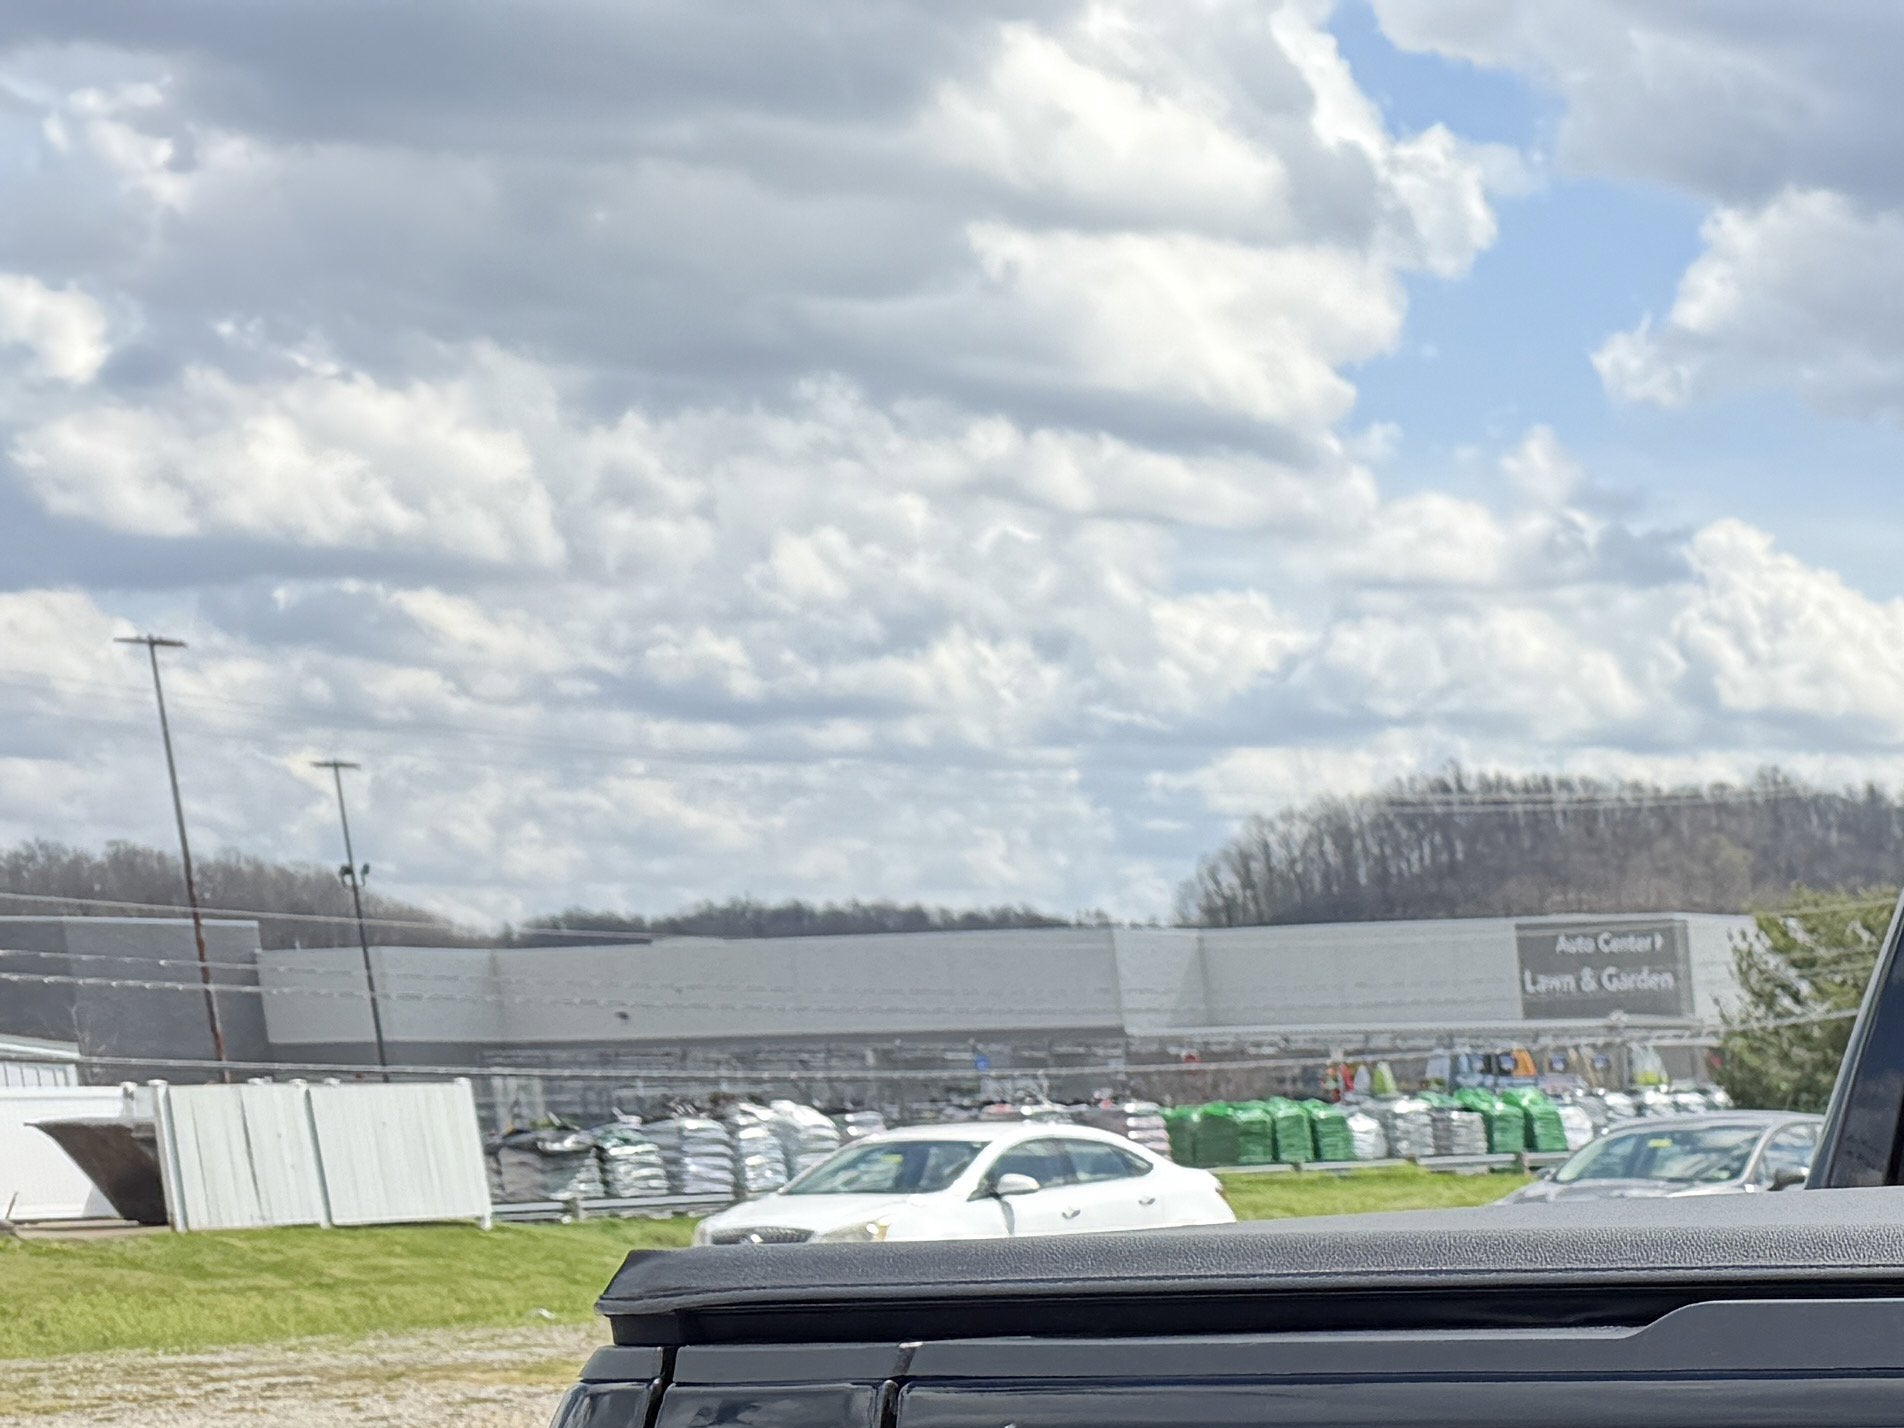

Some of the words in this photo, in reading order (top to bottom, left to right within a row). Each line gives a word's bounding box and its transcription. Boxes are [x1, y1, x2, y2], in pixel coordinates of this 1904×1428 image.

[1556, 934, 1595, 954] Auto
[1597, 931, 1653, 953] Center
[1524, 968, 1576, 993] Lawn
[1580, 966, 1598, 992] &
[1601, 966, 1675, 992] Garden
